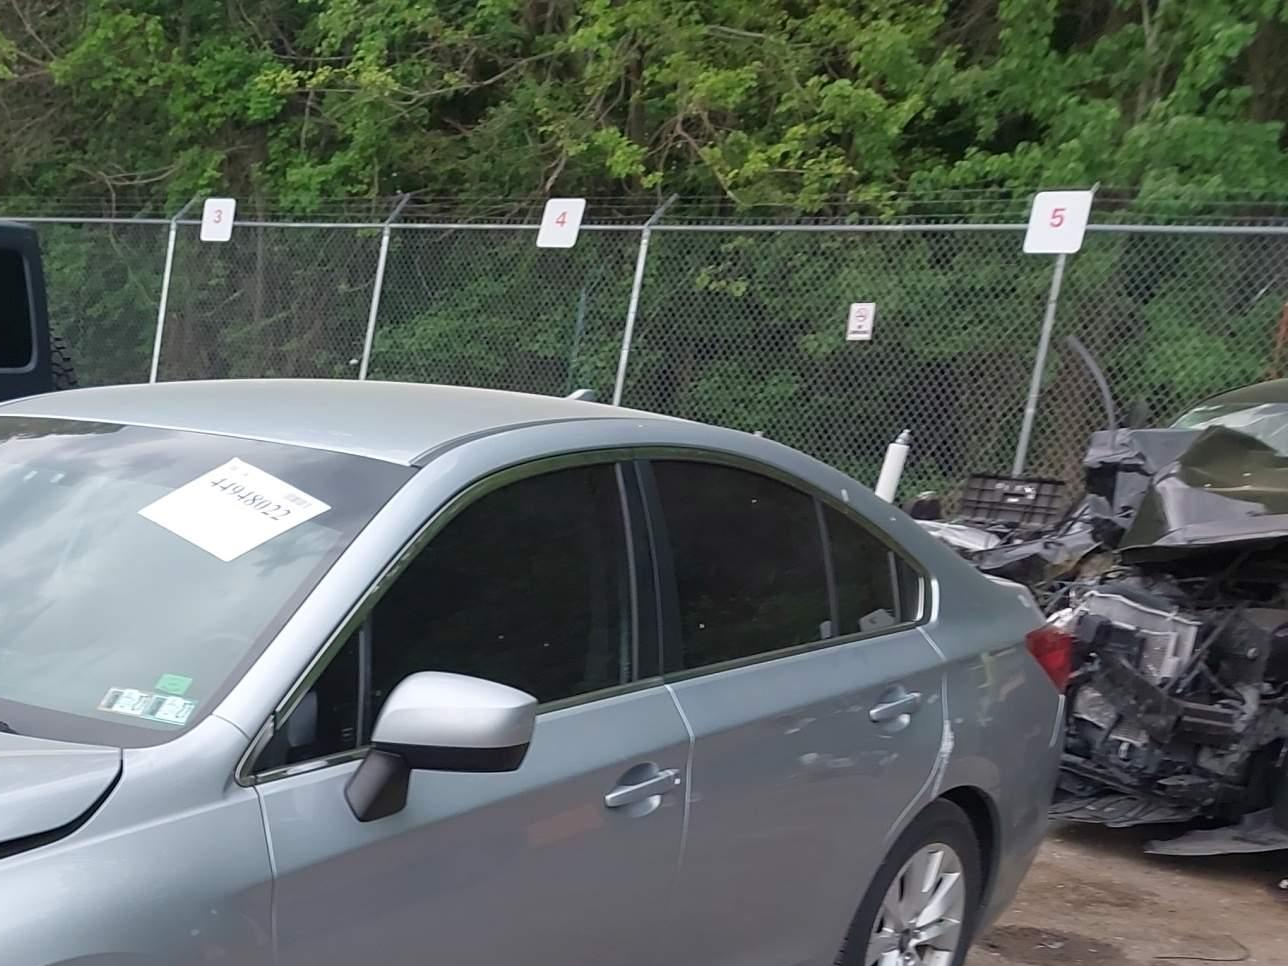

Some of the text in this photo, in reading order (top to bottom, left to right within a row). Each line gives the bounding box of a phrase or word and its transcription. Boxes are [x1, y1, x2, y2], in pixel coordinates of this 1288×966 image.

[213, 209, 223, 224] 3
[555, 210, 568, 228] 4
[1050, 207, 1066, 228] 5
[210, 478, 291, 521] 44948022
